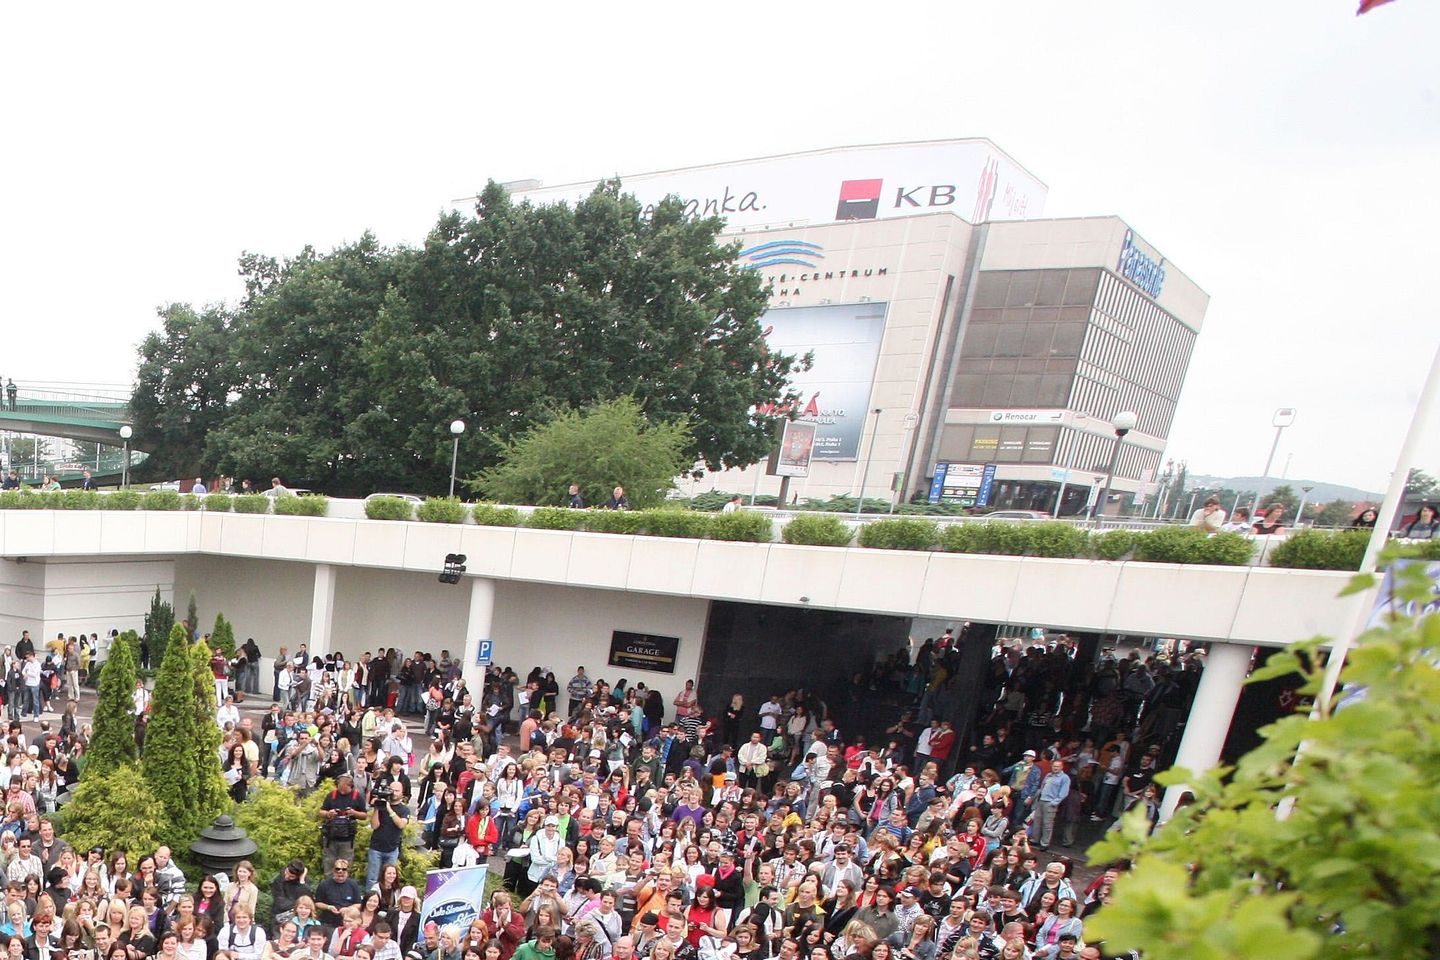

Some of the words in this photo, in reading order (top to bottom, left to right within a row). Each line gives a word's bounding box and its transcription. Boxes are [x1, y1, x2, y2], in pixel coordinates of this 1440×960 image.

[681, 185, 767, 218] anka.
[893, 184, 957, 208] KB
[1004, 412, 1038, 420] Renocar
[480, 641, 490, 657] P
[626, 645, 661, 656] GARAGE
